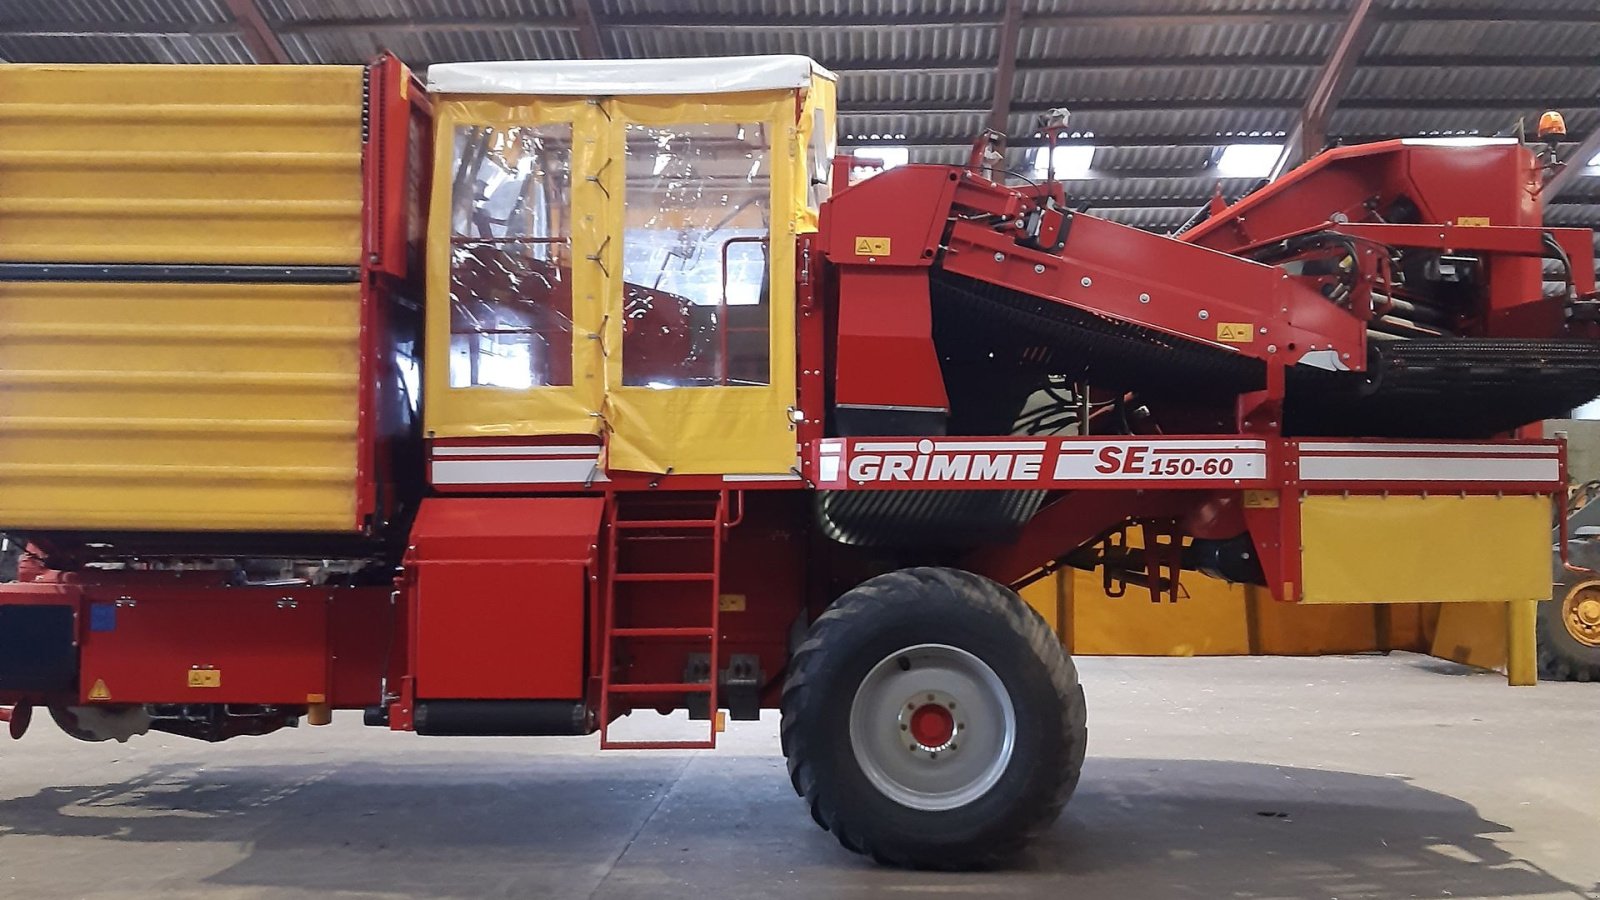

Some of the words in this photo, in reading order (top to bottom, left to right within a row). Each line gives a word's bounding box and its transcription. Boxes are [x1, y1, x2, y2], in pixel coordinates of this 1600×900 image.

[849, 440, 1043, 481] GRIMME
[1094, 446, 1149, 474] SE
[1149, 457, 1233, 476] 150-60
